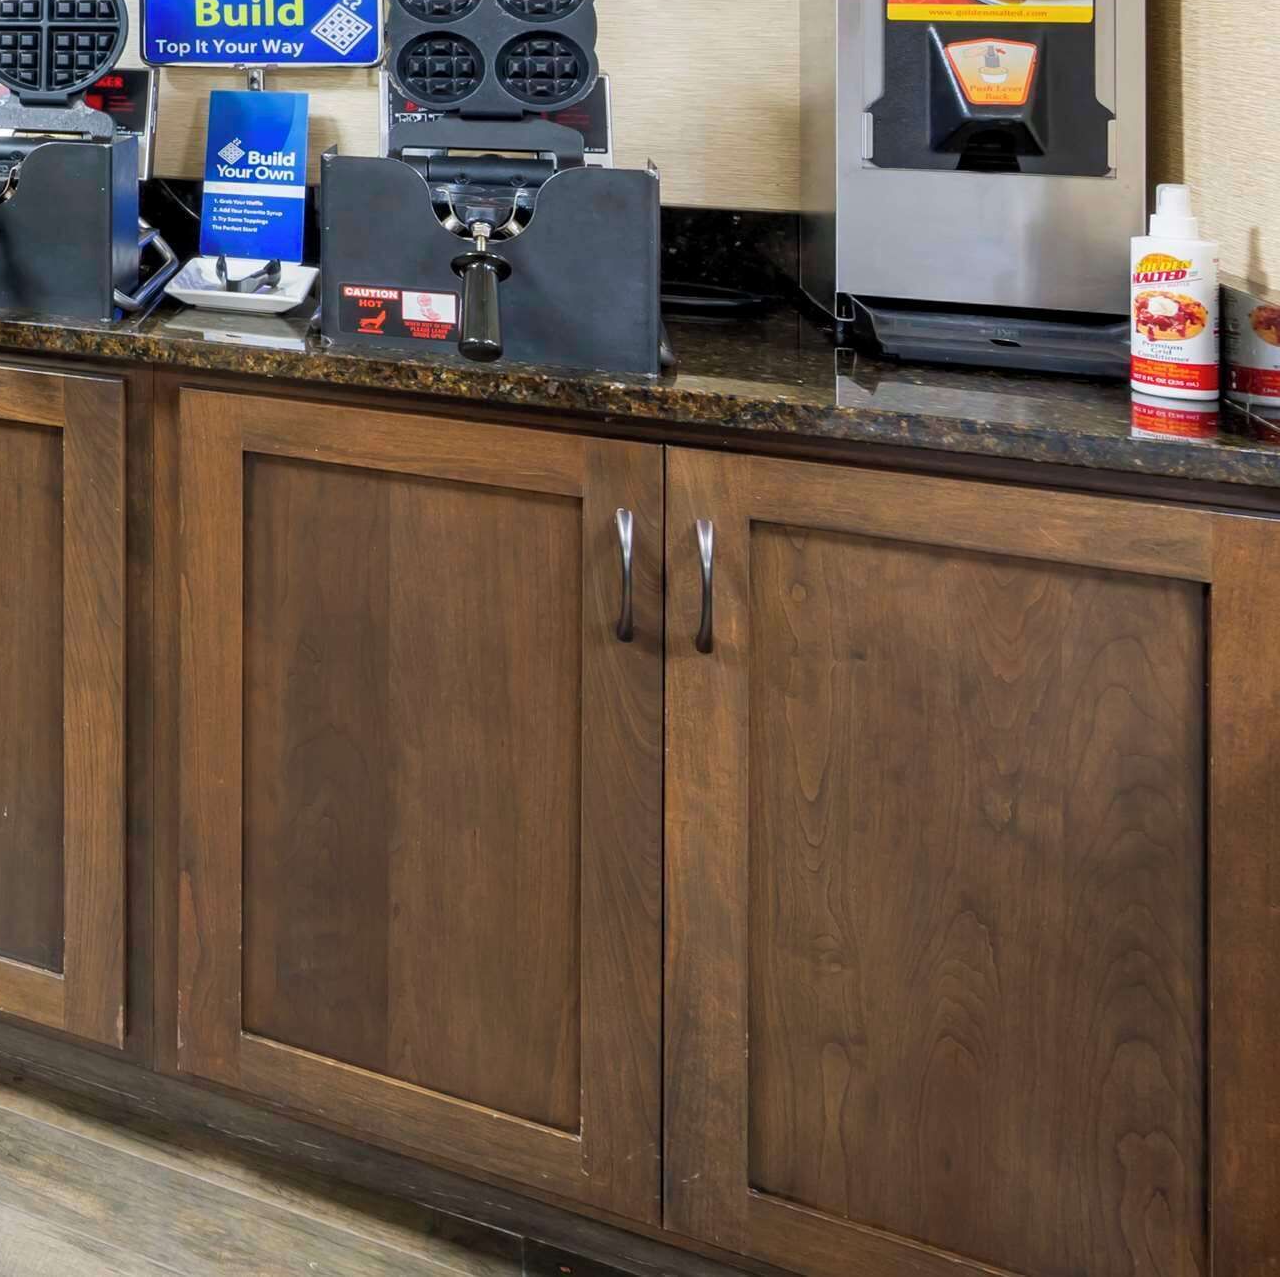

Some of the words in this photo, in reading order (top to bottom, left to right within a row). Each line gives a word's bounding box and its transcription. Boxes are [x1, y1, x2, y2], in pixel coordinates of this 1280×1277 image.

[155, 39, 190, 57] Top
[195, 39, 208, 54] It
[213, 39, 257, 54] Your
[262, 39, 304, 58] Way
[248, 150, 296, 167] Build
[216, 164, 253, 179] Your
[255, 166, 295, 181] Own
[243, 217, 269, 225] Toppings
[344, 286, 399, 300] CAUTION
[358, 299, 383, 308] HOT
